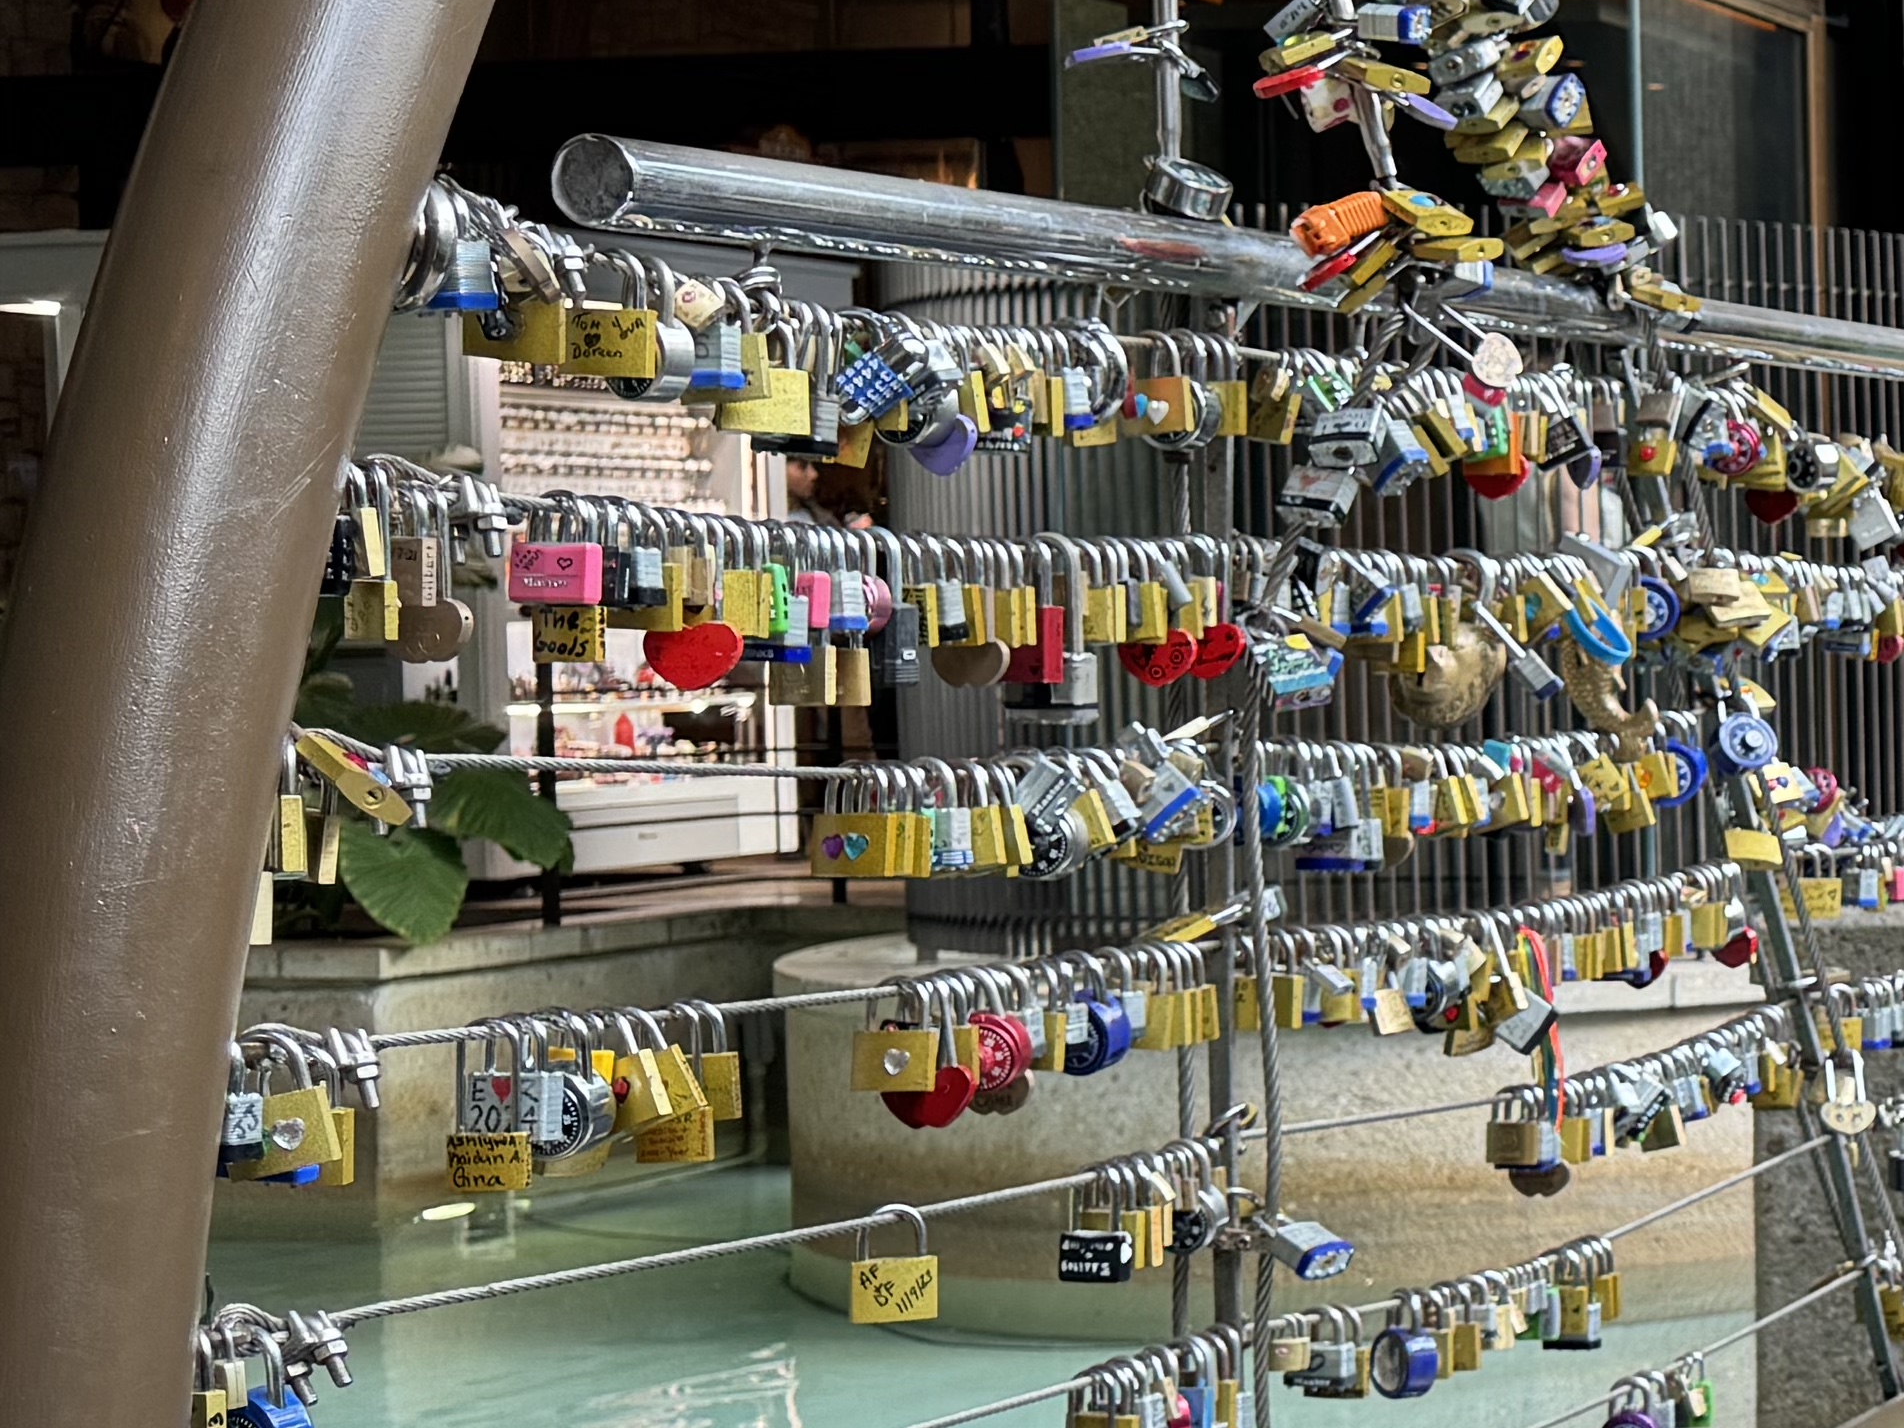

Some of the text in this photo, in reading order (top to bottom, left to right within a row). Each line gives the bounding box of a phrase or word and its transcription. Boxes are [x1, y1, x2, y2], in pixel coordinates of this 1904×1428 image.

[539, 608, 579, 630] The
[533, 636, 590, 658] Goods
[1031, 778, 1066, 817] Master
[472, 1078, 487, 1102] E
[453, 1167, 506, 1189] Gina
